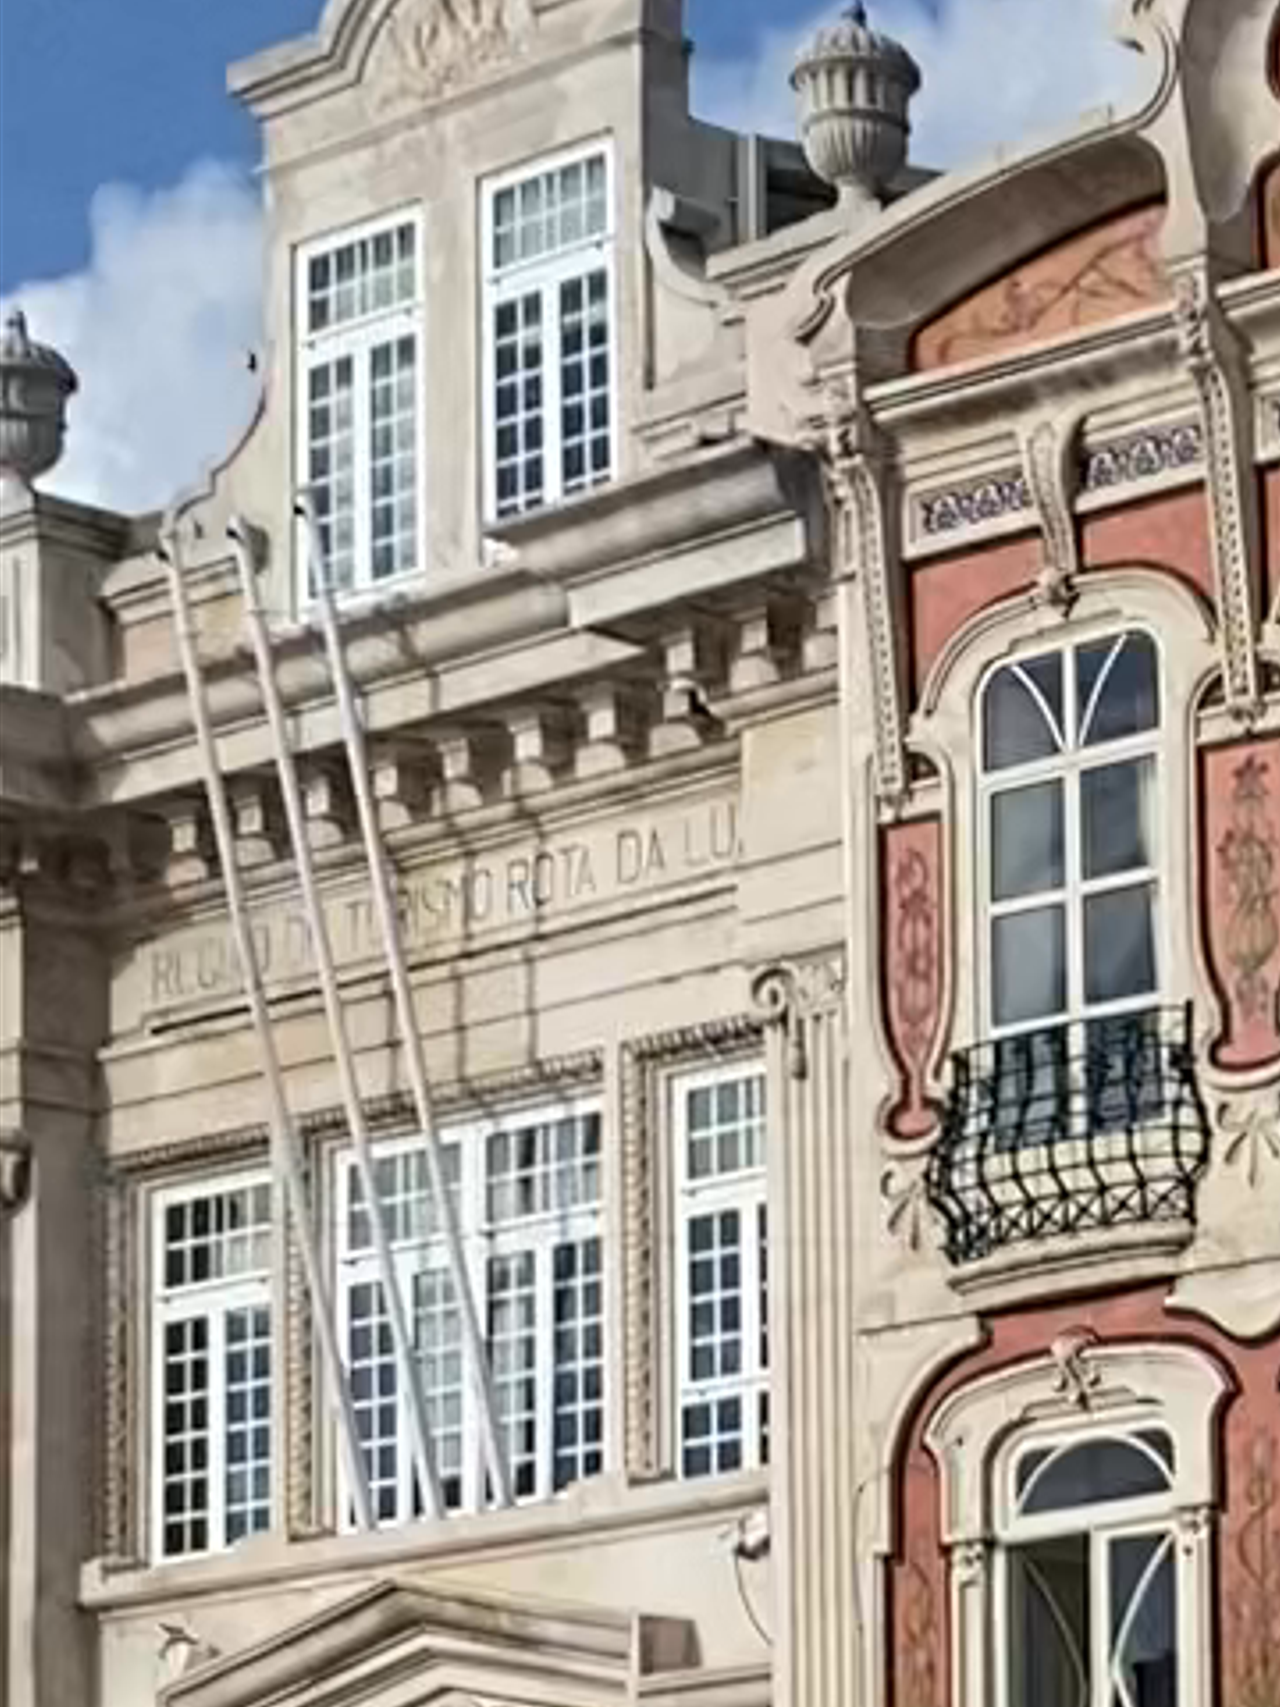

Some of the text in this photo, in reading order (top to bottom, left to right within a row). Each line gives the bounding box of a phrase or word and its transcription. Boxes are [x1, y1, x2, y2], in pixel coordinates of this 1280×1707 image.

[506, 842, 598, 915] ROTA
[616, 825, 666, 885] DA
[683, 800, 744, 867] LU
